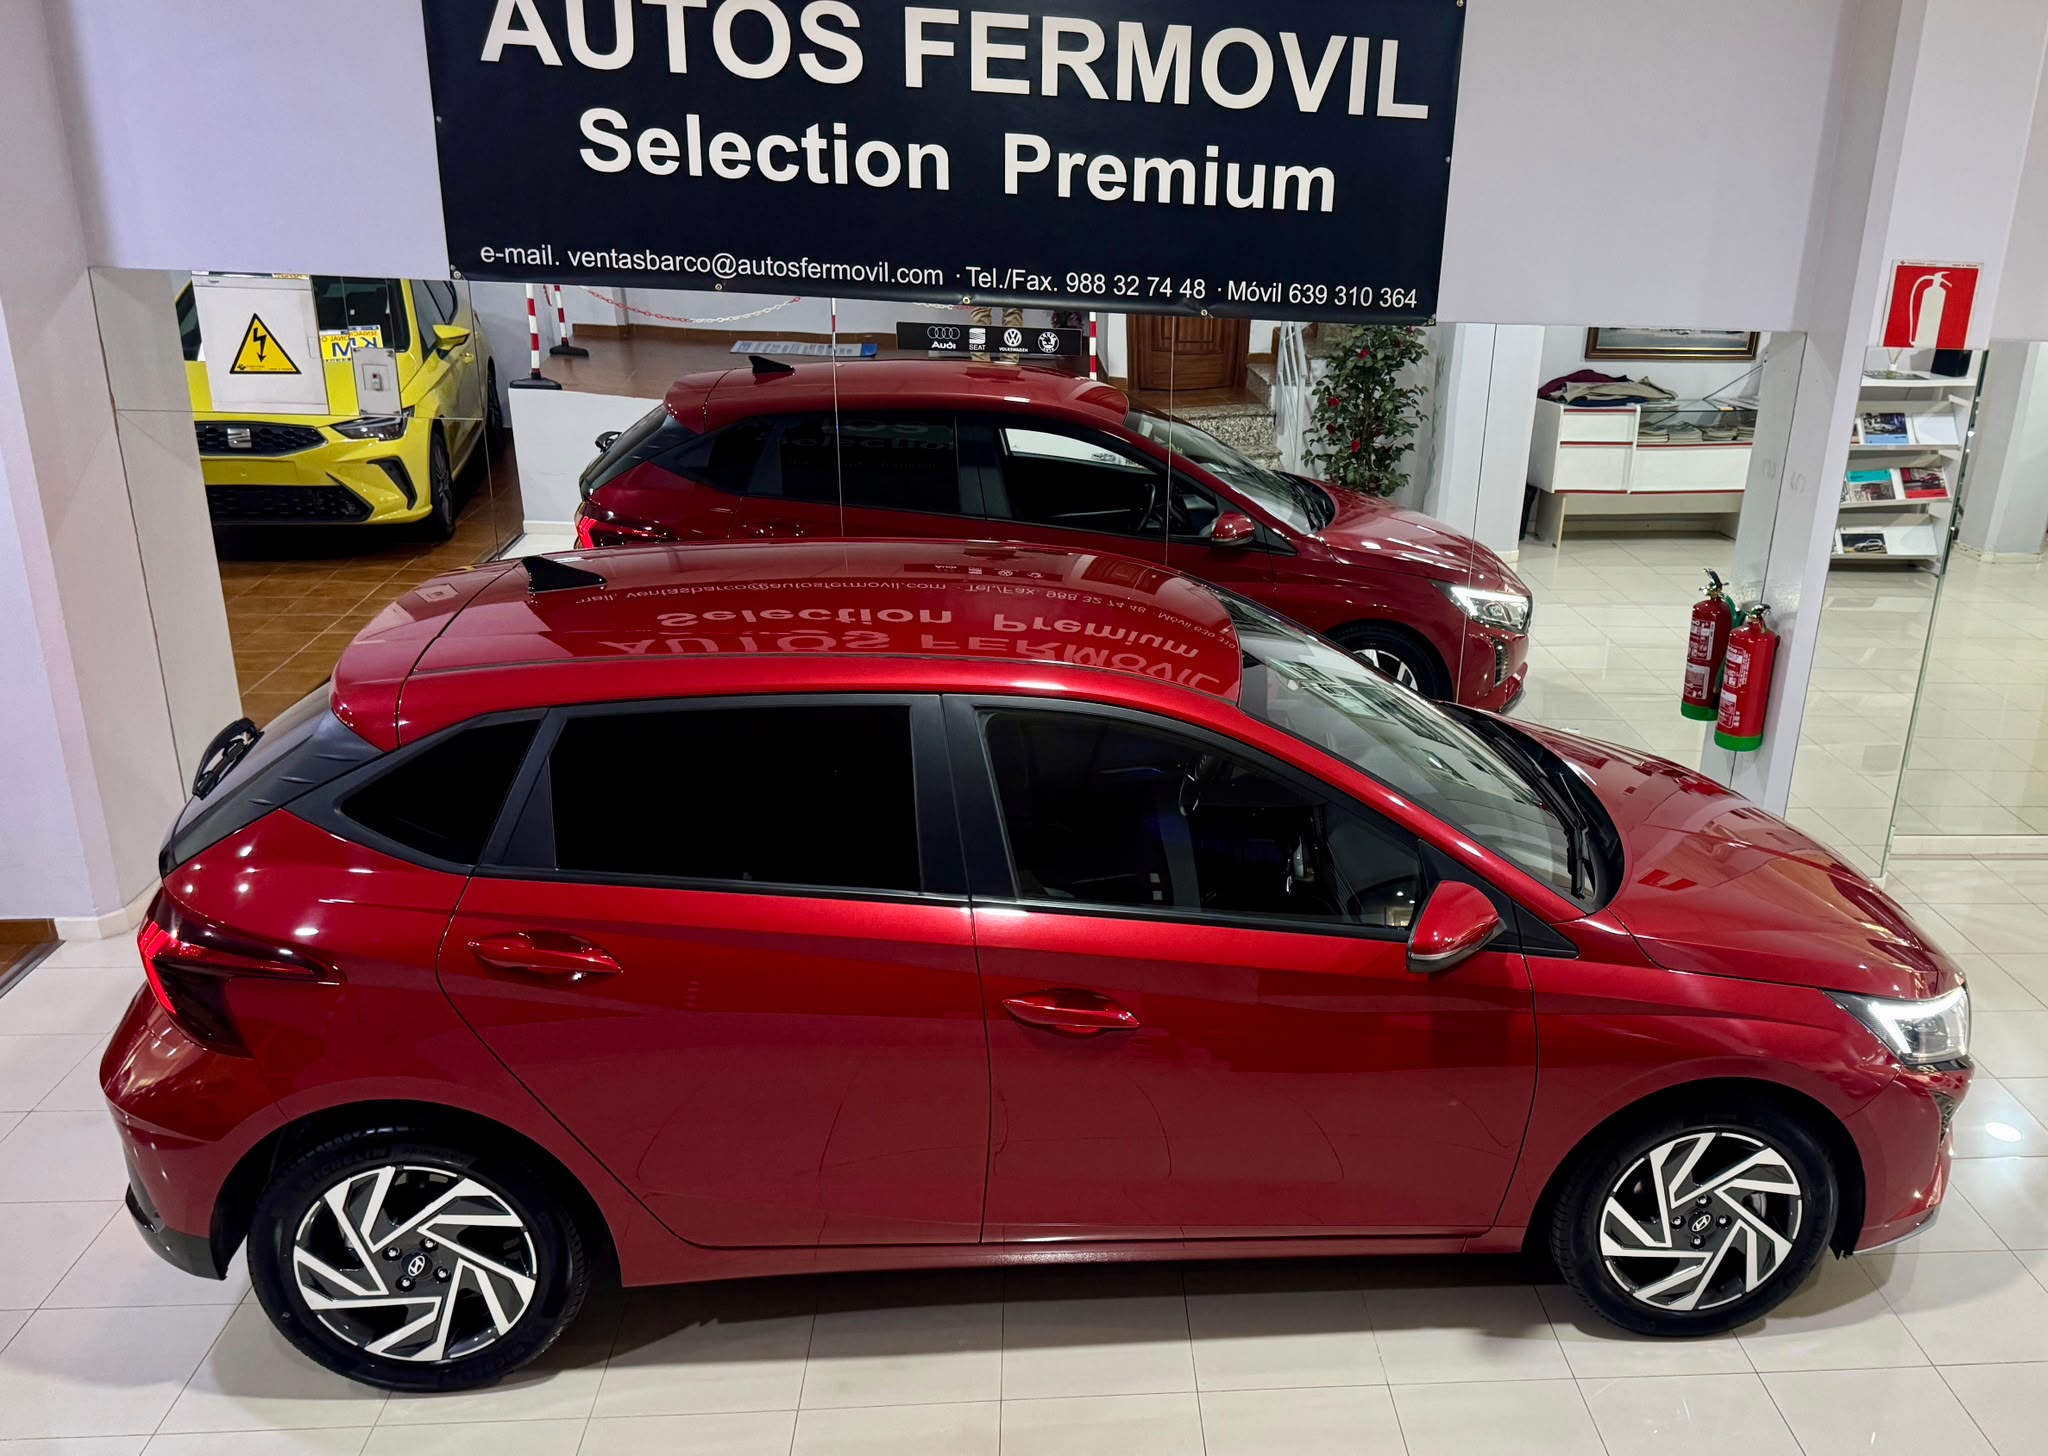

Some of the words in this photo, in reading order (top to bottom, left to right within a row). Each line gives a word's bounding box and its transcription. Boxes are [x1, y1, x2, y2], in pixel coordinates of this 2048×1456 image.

[481, 0, 864, 85] AUTOS
[904, 6, 1429, 120] FERMOVIL
[579, 107, 950, 191] Selection
[1004, 132, 1335, 213] Premium
[480, 246, 560, 267] e-mail.
[567, 249, 944, 286] ventasbarco@autosfermovil.com
[965, 266, 1058, 292] Tel./Fax.
[1065, 271, 1106, 295] 988
[1113, 274, 1140, 296] 32
[1146, 276, 1173, 298] 74
[1178, 277, 1206, 300] 48
[1227, 280, 1282, 303] Móvil
[1288, 283, 1328, 305] 639
[1334, 285, 1373, 307] 310
[1379, 287, 1418, 309] 364
[931, 340, 957, 350] Audi
[968, 343, 986, 351] SEAT
